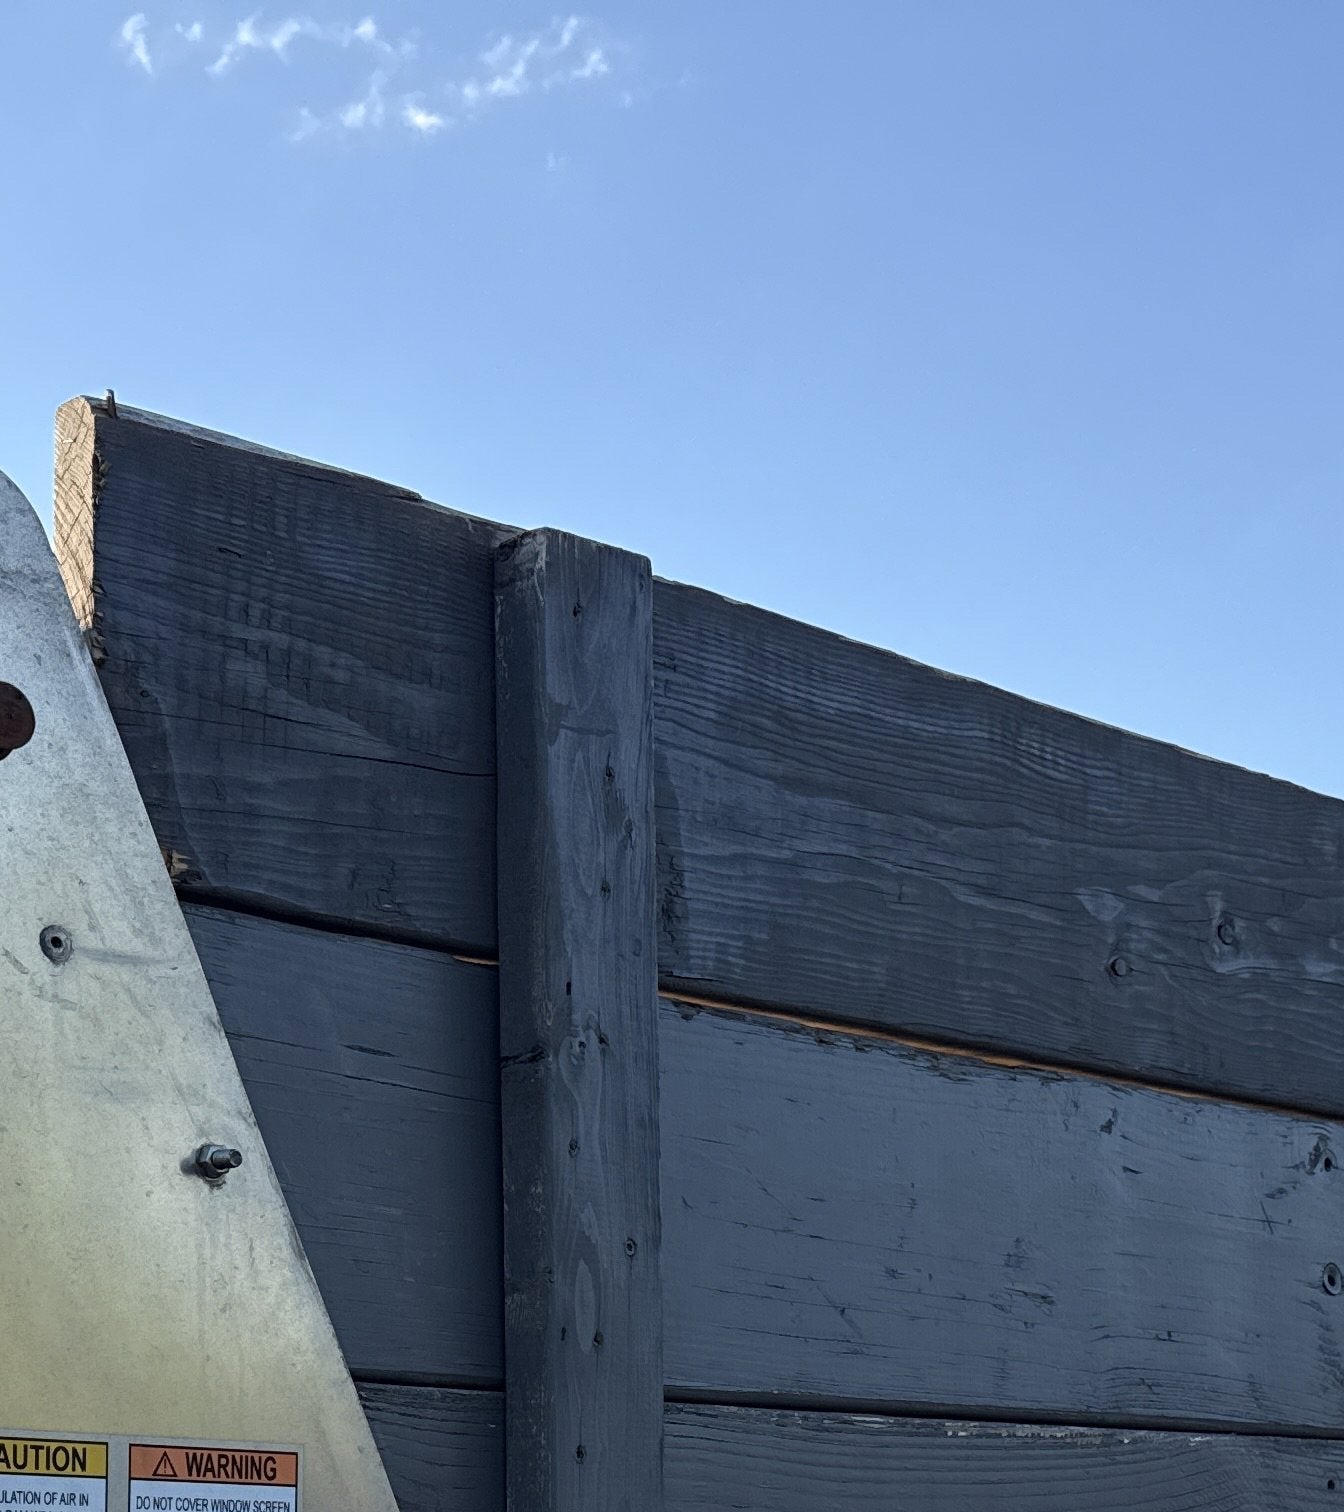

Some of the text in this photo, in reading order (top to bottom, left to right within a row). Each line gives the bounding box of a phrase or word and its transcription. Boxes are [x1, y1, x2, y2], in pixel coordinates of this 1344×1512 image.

[185, 1452, 277, 1481] WARNING
[44, 1491, 57, 1505] OF
[59, 1492, 76, 1506] AIR
[79, 1493, 89, 1506] IN
[136, 1496, 150, 1510] DO
[153, 1496, 173, 1511] NOT
[175, 1497, 208, 1512] COVER
